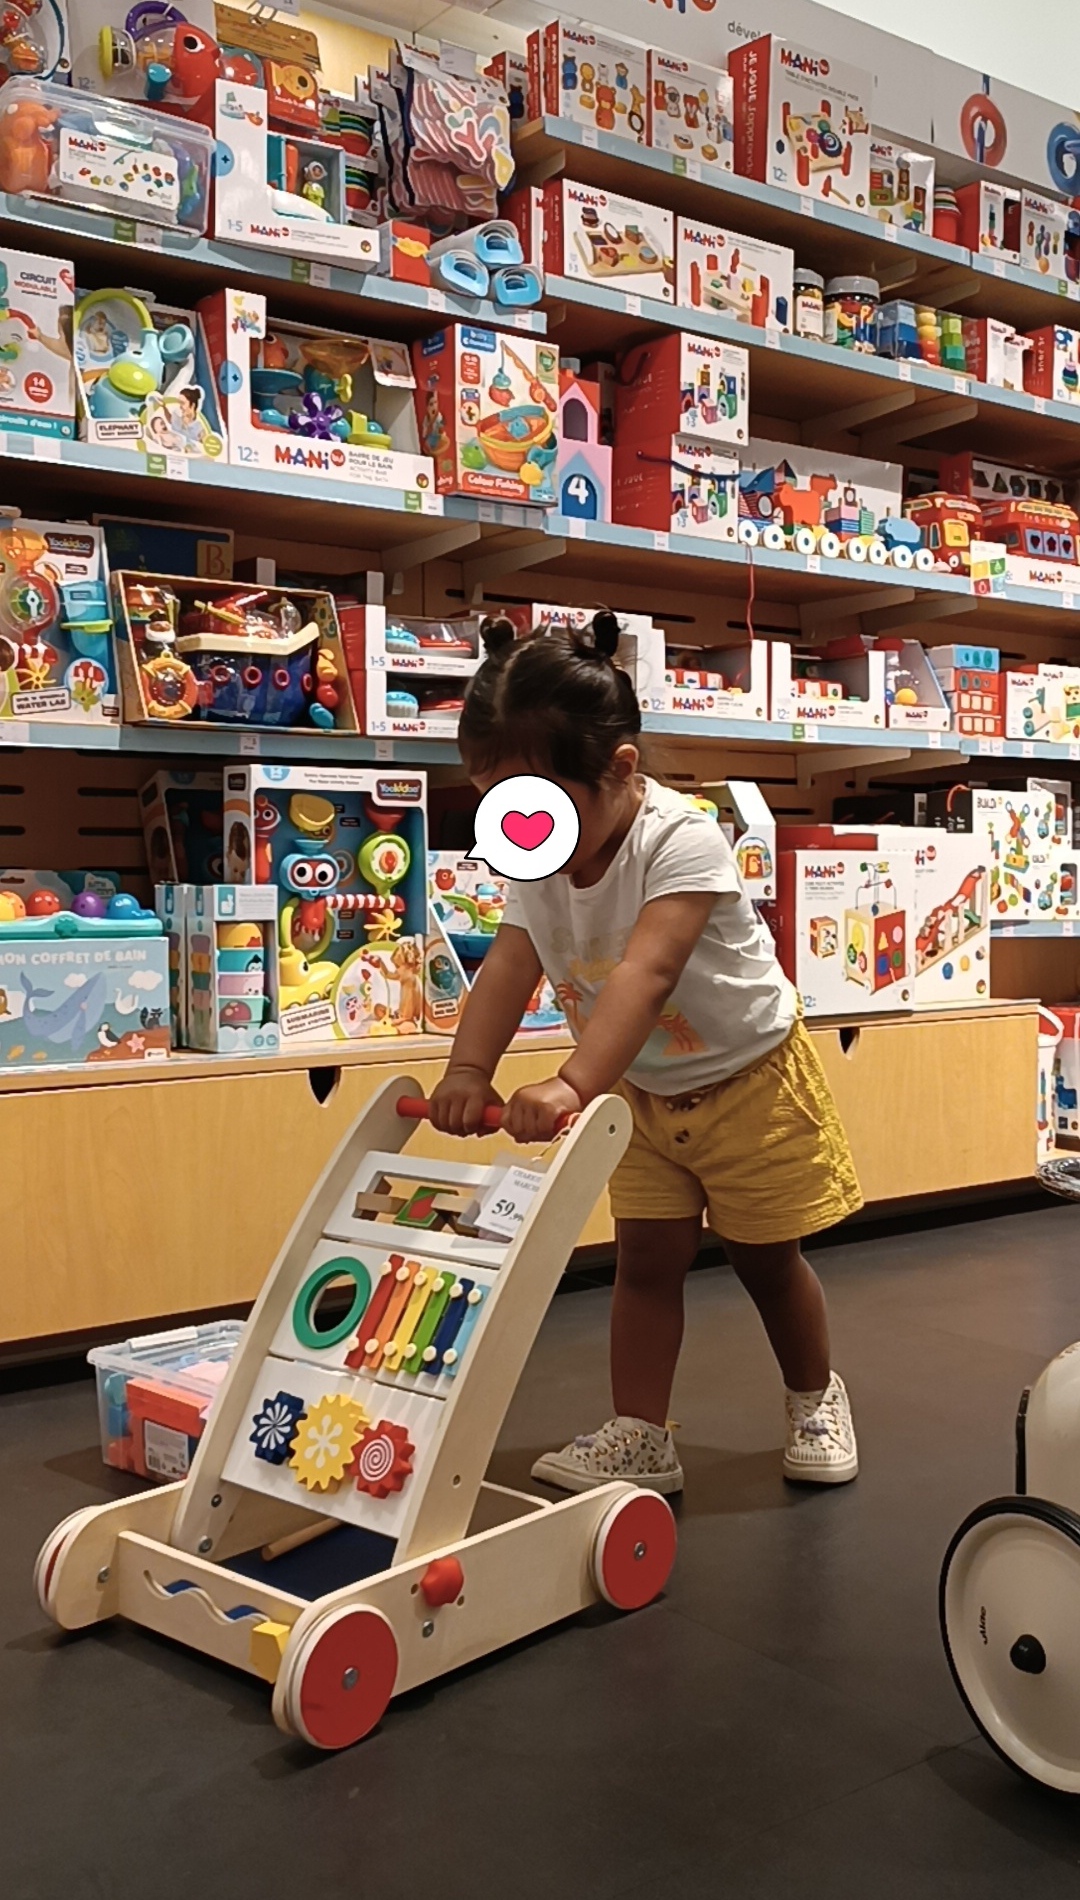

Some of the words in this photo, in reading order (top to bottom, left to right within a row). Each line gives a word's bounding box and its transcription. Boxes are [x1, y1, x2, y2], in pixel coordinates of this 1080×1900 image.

[727, 20, 761, 40] déve
[20, 271, 57, 286] CIRCUIT
[567, 477, 589, 505] 4
[31, 950, 90, 966] COFFRET
[94, 949, 111, 964] DE
